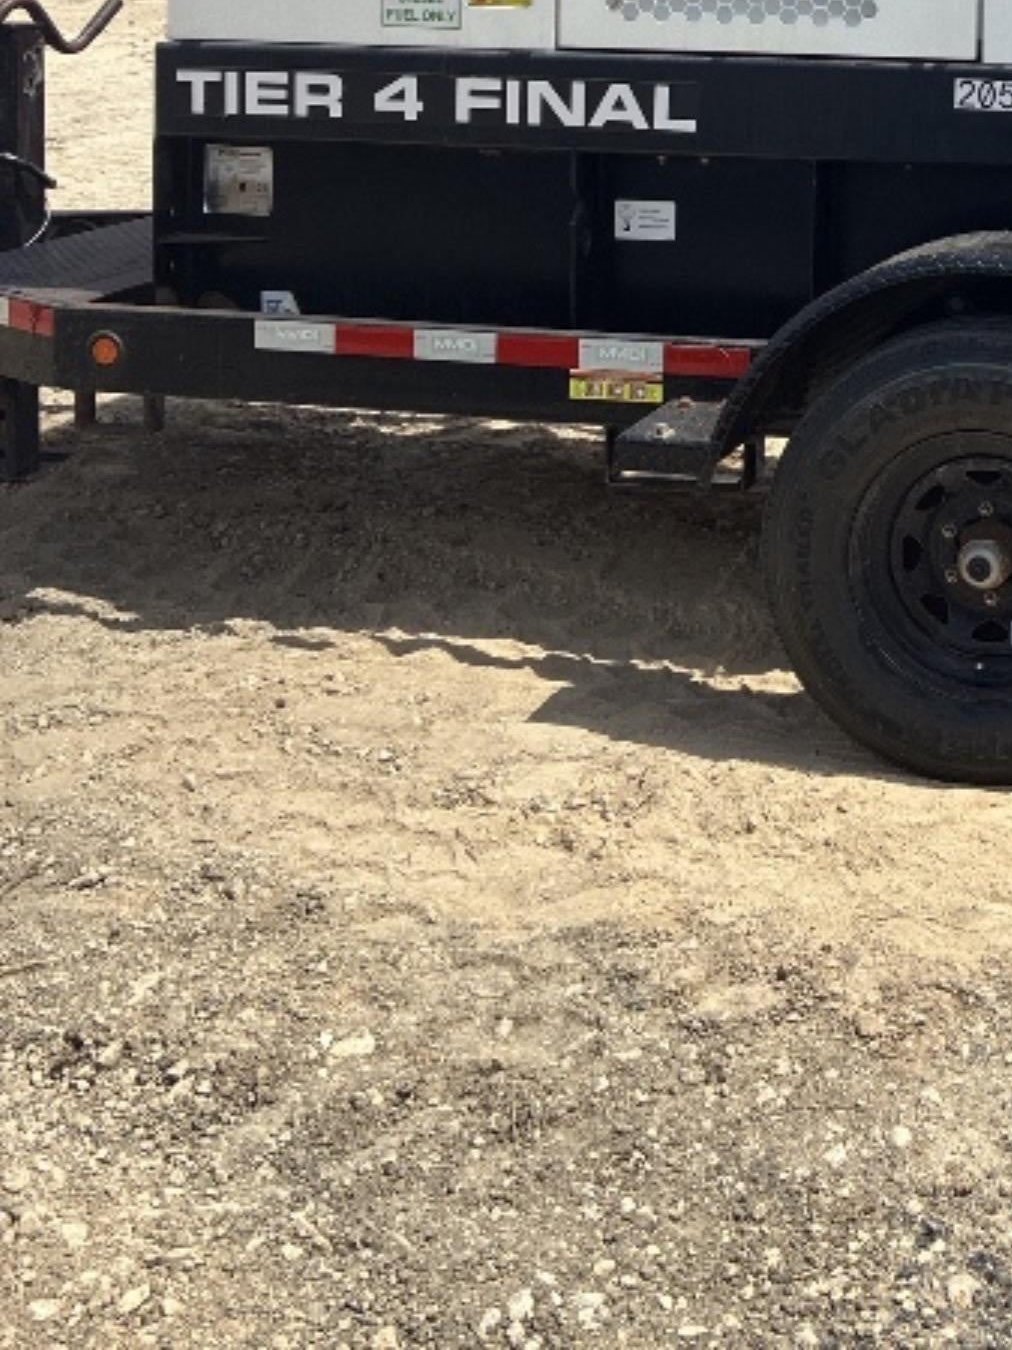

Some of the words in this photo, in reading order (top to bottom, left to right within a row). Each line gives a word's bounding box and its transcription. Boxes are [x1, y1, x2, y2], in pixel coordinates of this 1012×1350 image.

[176, 68, 343, 118] TIER
[373, 74, 424, 121] 4
[455, 76, 697, 133] FINAL
